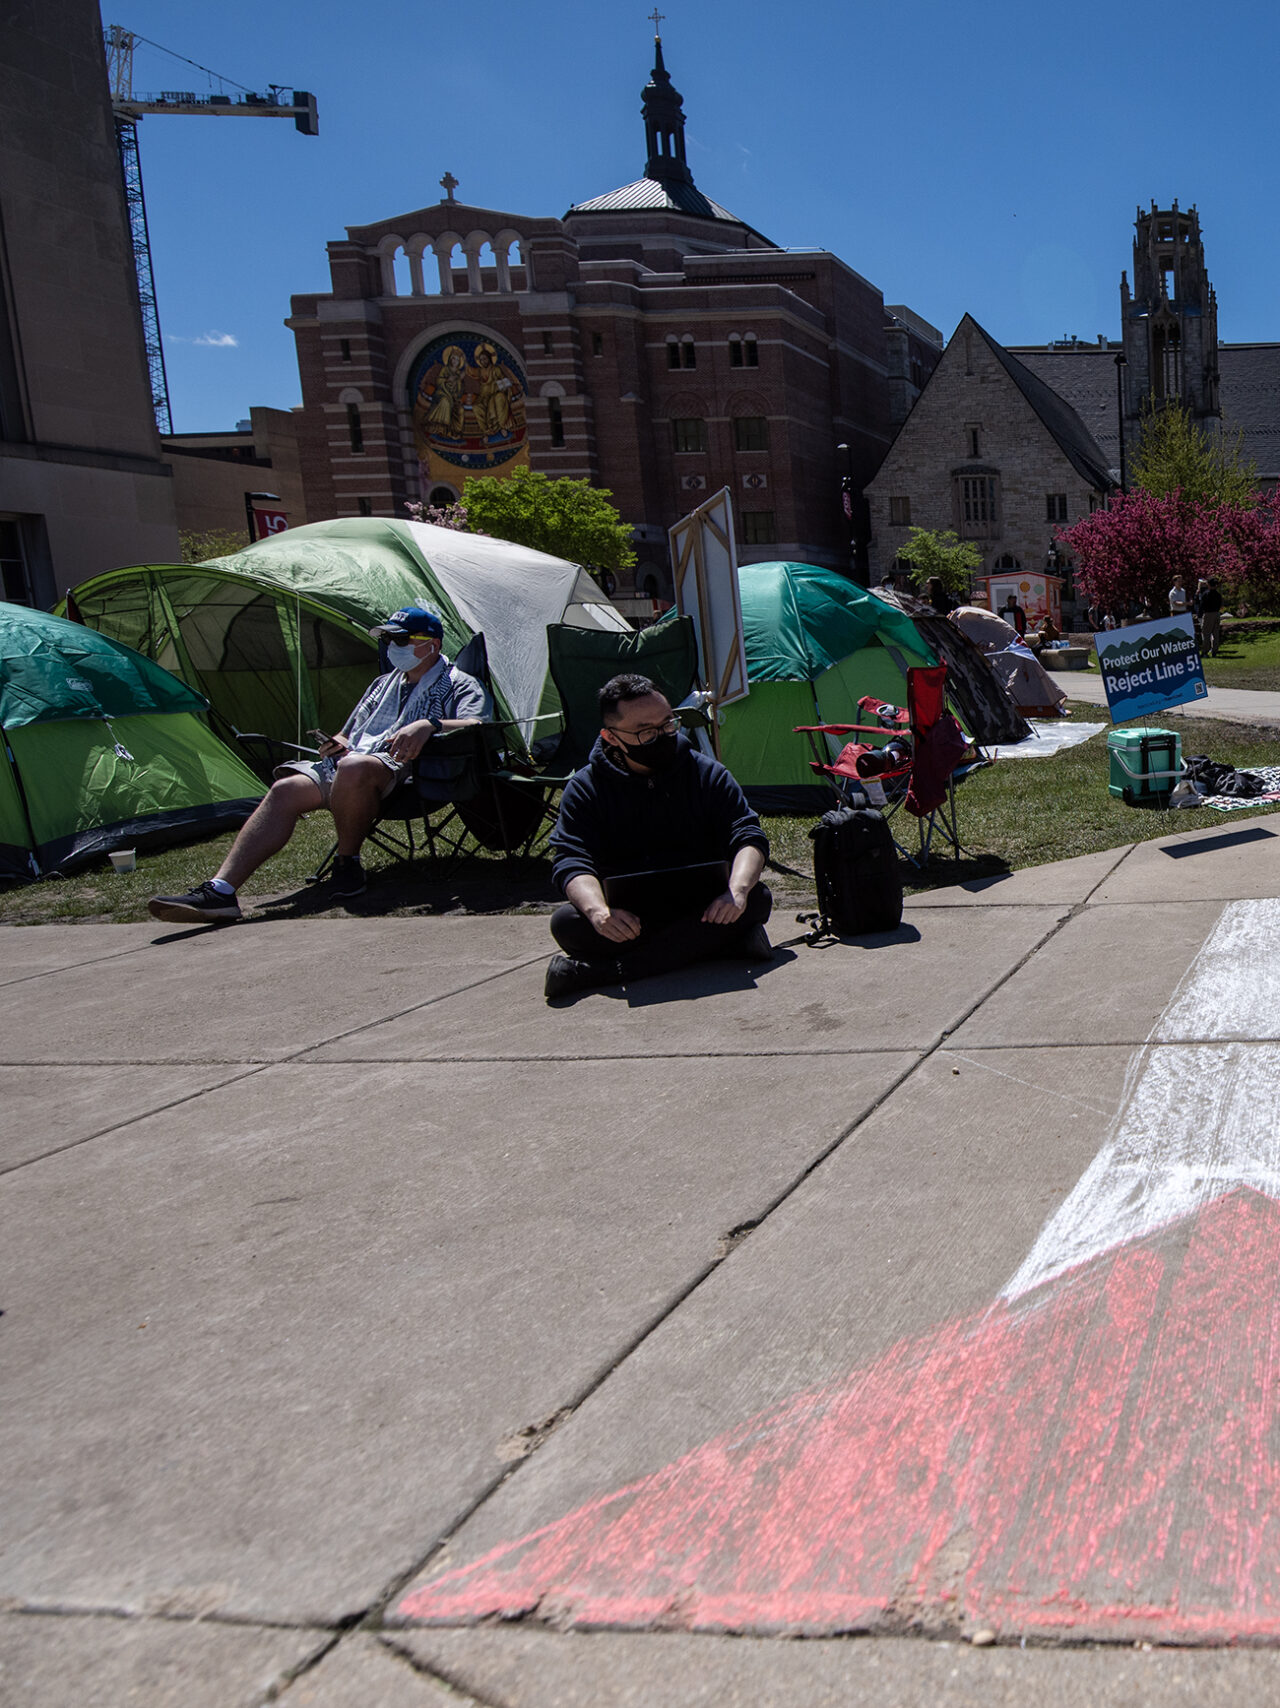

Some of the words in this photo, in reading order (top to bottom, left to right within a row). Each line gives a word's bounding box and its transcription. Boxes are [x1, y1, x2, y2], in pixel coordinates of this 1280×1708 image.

[1103, 651, 1140, 670] Protect
[1141, 647, 1160, 660] Our
[1161, 639, 1195, 655] Waters
[1106, 667, 1154, 694] Reject
[1154, 661, 1184, 681] Line
[1186, 654, 1200, 672] 5!
